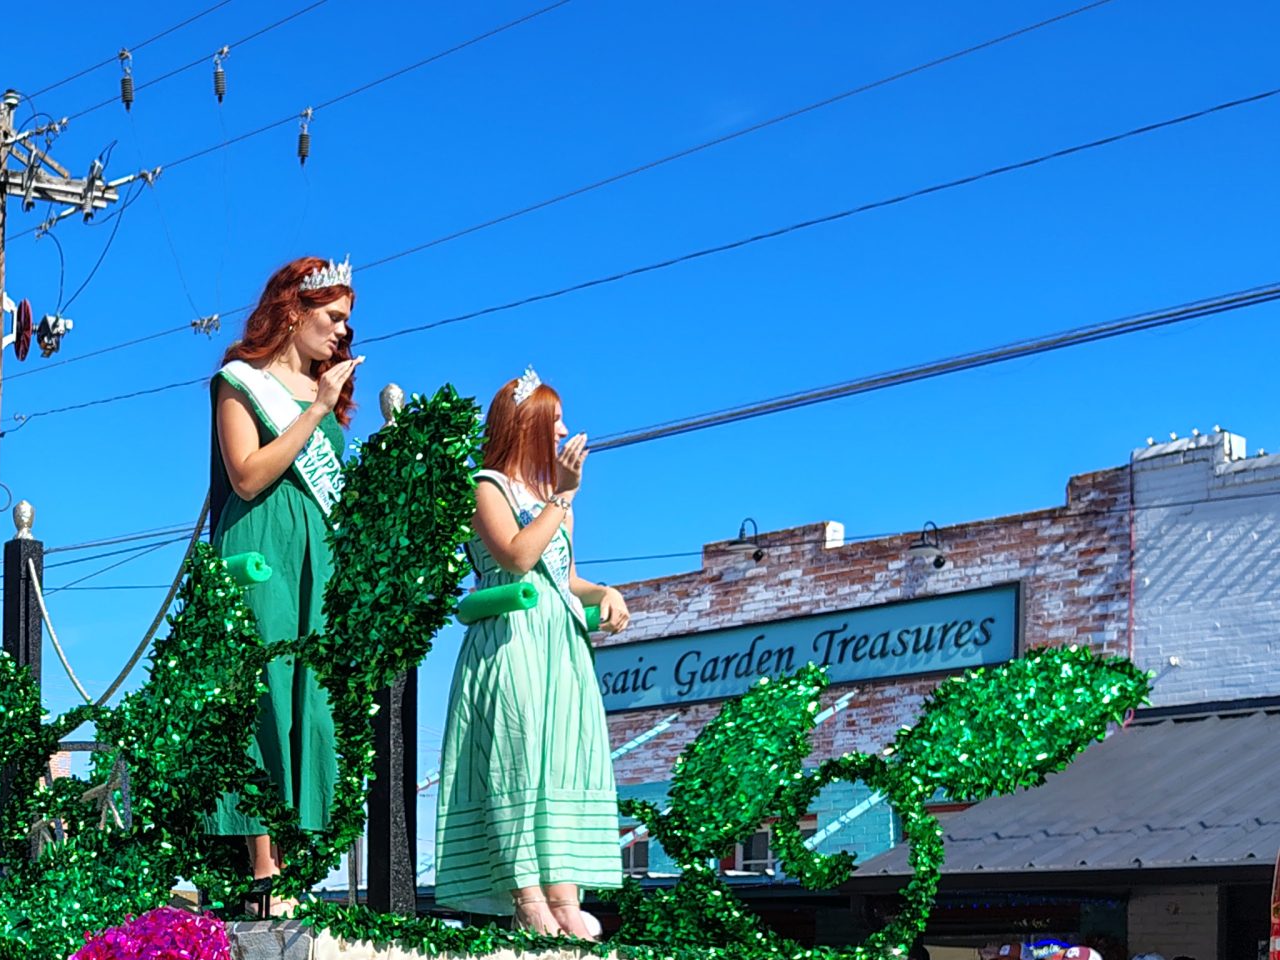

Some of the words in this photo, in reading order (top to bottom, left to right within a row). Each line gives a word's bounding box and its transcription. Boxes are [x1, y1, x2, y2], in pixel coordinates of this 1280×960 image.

[602, 656, 657, 696] saic
[674, 634, 795, 696] Garden
[813, 617, 995, 666] Treasures
